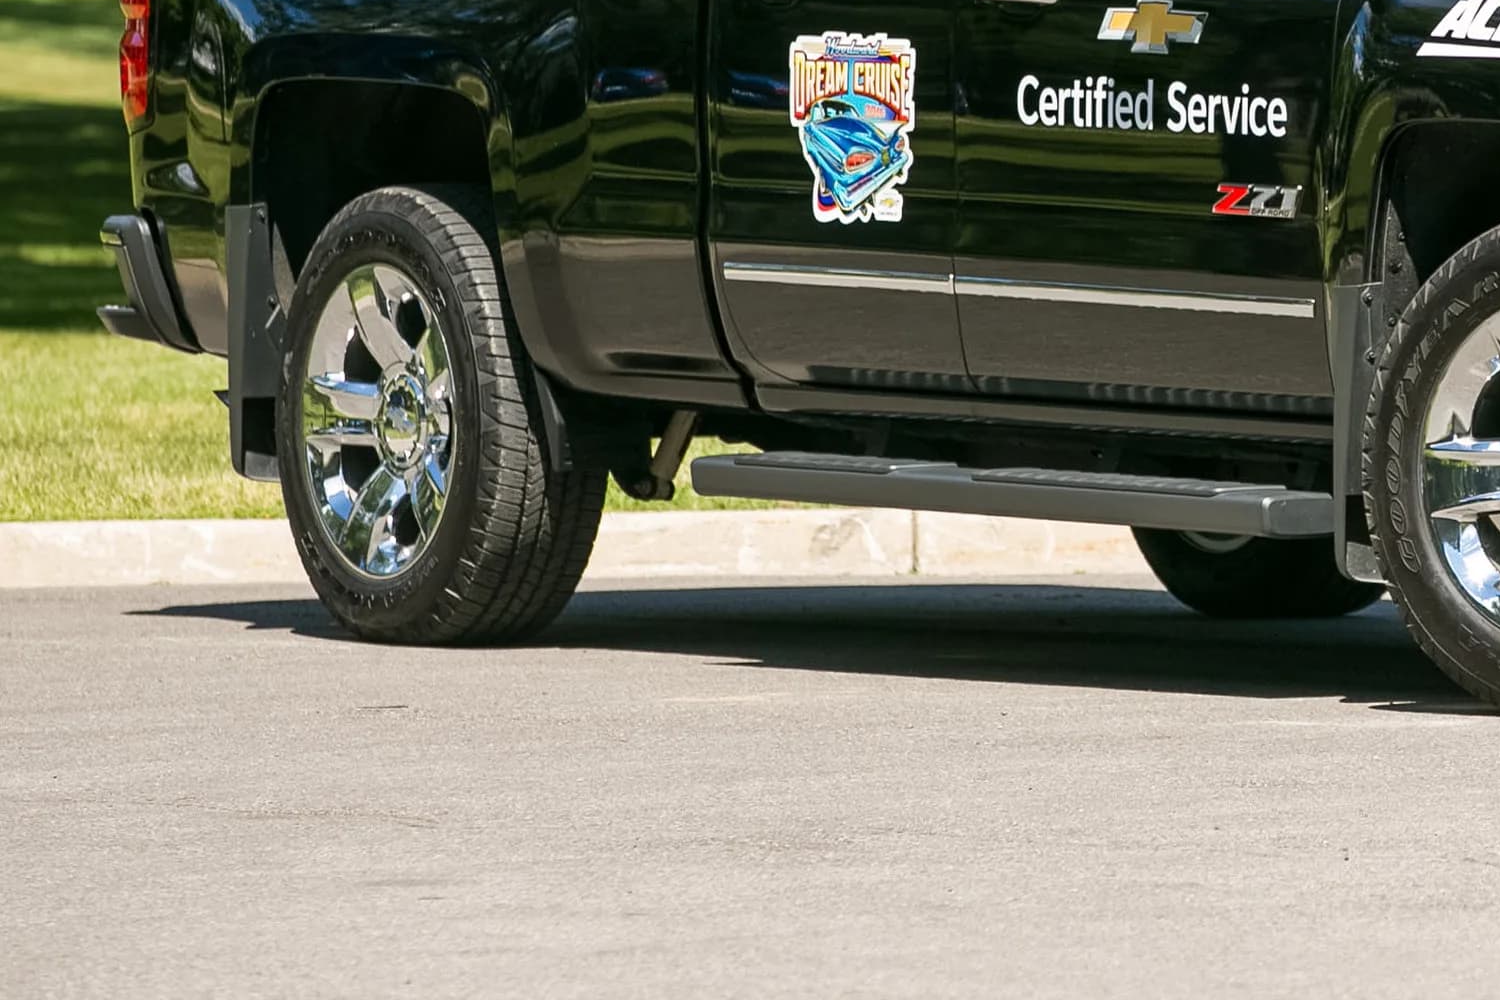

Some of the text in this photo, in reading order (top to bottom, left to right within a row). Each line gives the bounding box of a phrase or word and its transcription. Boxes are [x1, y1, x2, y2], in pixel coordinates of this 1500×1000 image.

[794, 50, 911, 122] DREAM CRUISE
[1017, 74, 1288, 138] Certified Service
[1212, 183, 1302, 218] Z71
